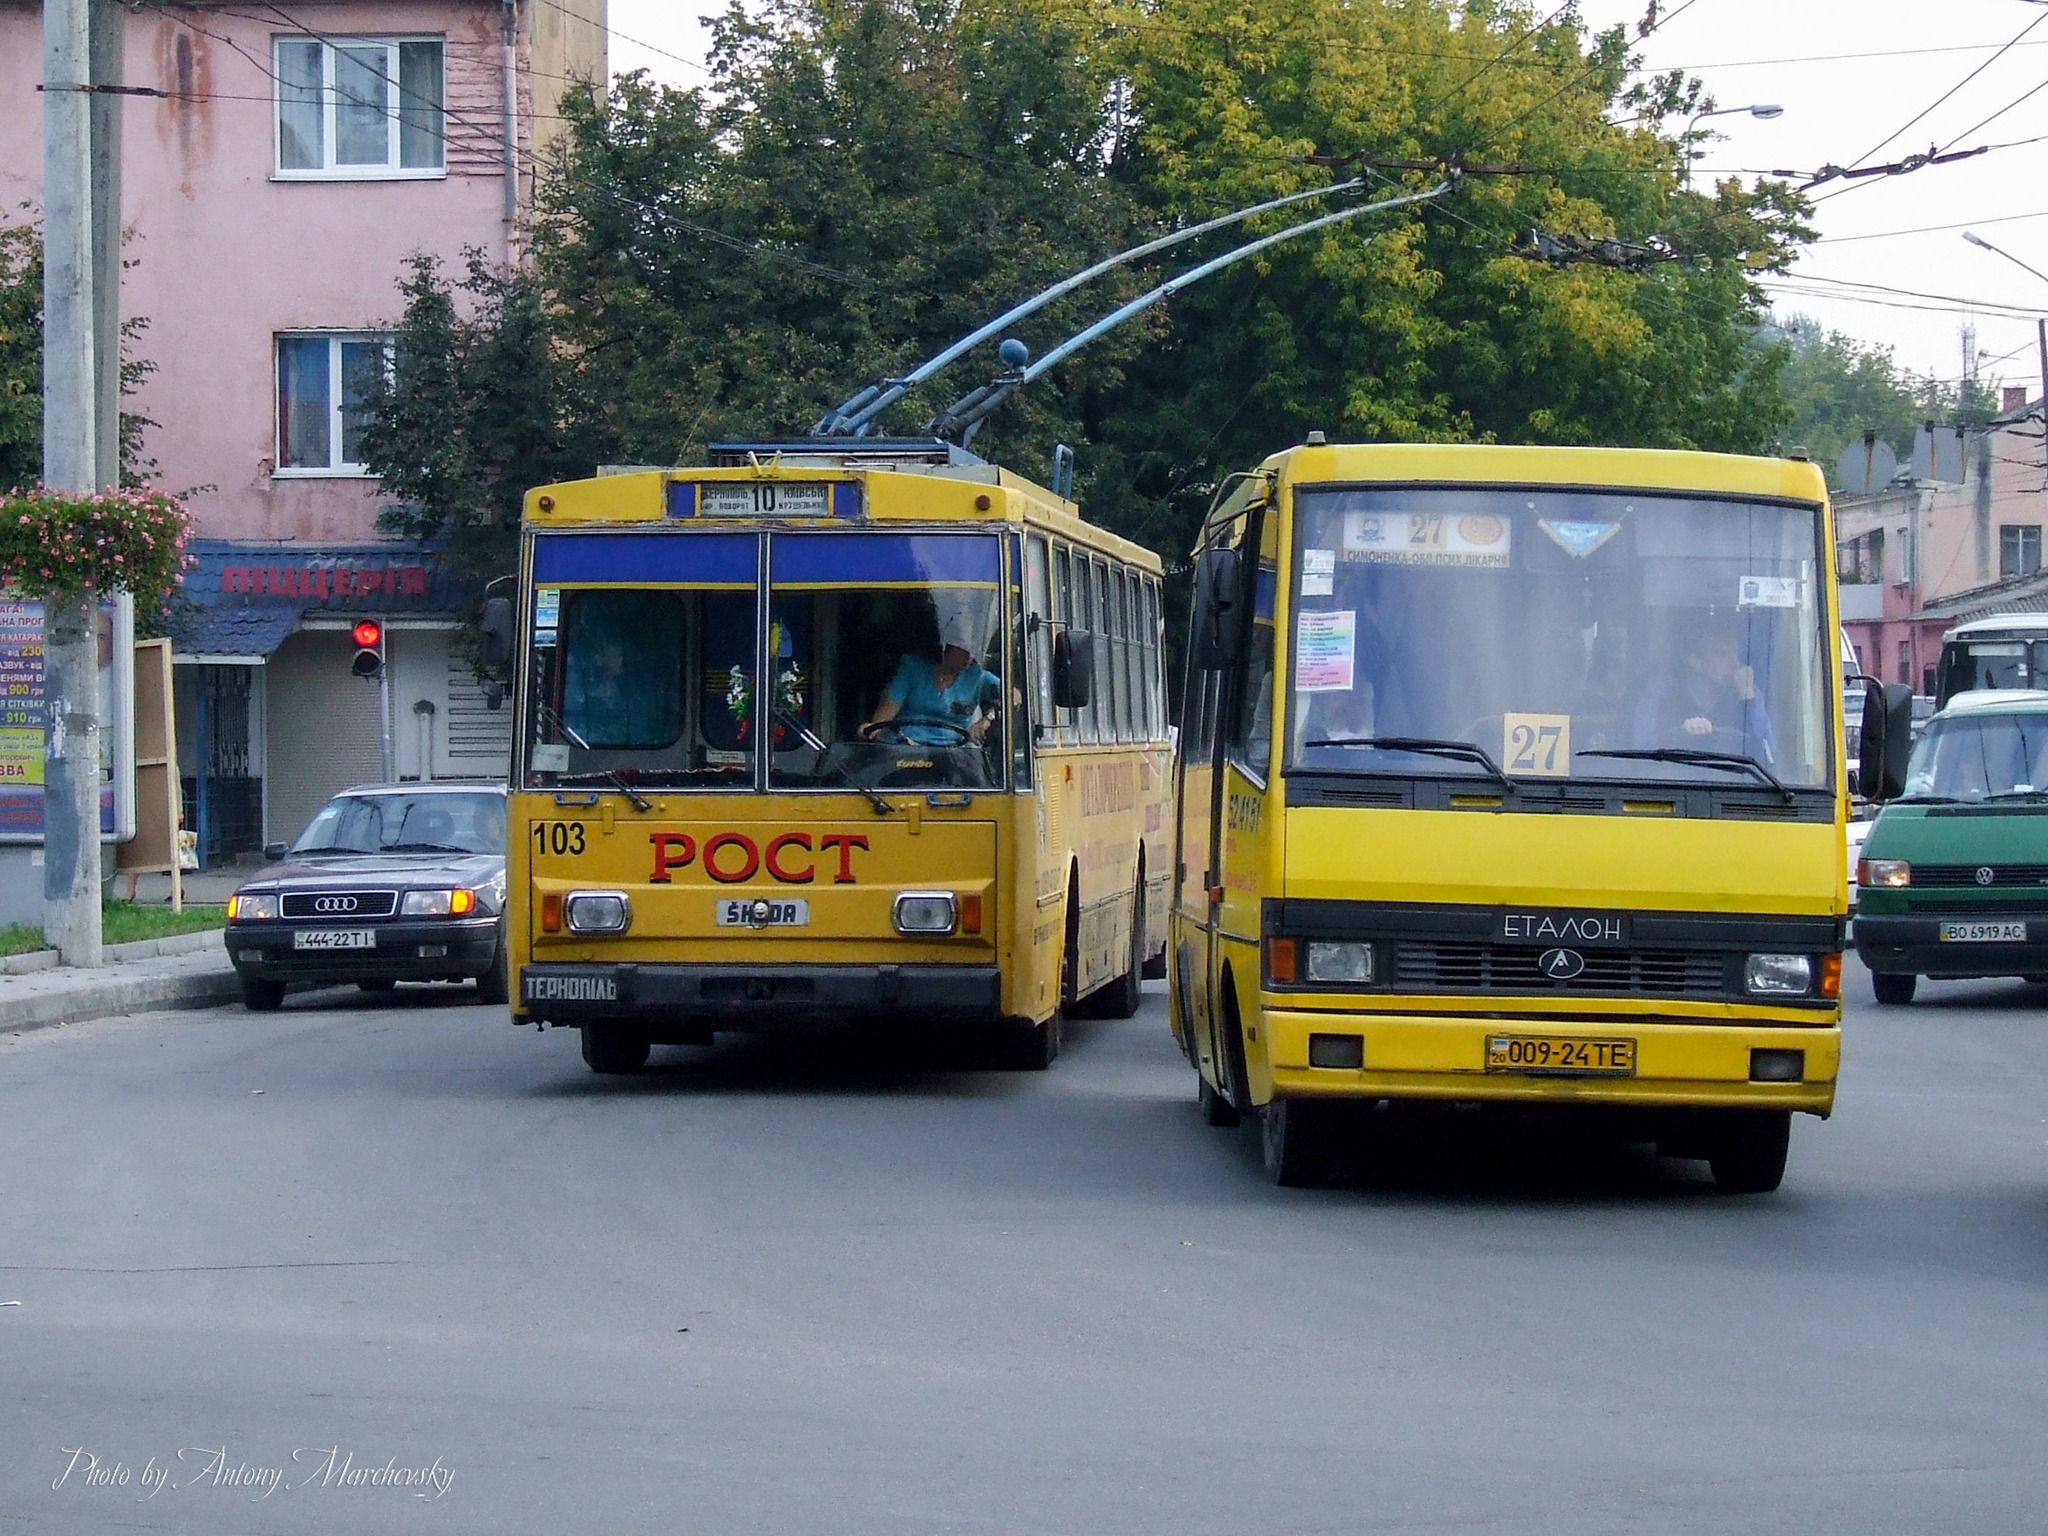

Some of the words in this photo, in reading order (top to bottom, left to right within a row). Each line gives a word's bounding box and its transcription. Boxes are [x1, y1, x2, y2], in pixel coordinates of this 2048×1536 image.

[752, 485, 776, 512] 10
[1410, 512, 1443, 545] 27
[223, 567, 425, 600] ПІЦЦЕРІЯ
[9, 684, 29, 695] 900
[1511, 725, 1562, 770] 27
[534, 822, 586, 855] 103
[649, 832, 870, 883] РОСТ
[1504, 915, 1620, 940] ЕТАЛОН
[526, 977, 617, 1000] ТЕРНОПІЛЬ
[1492, 1053, 1506, 1063] 20
